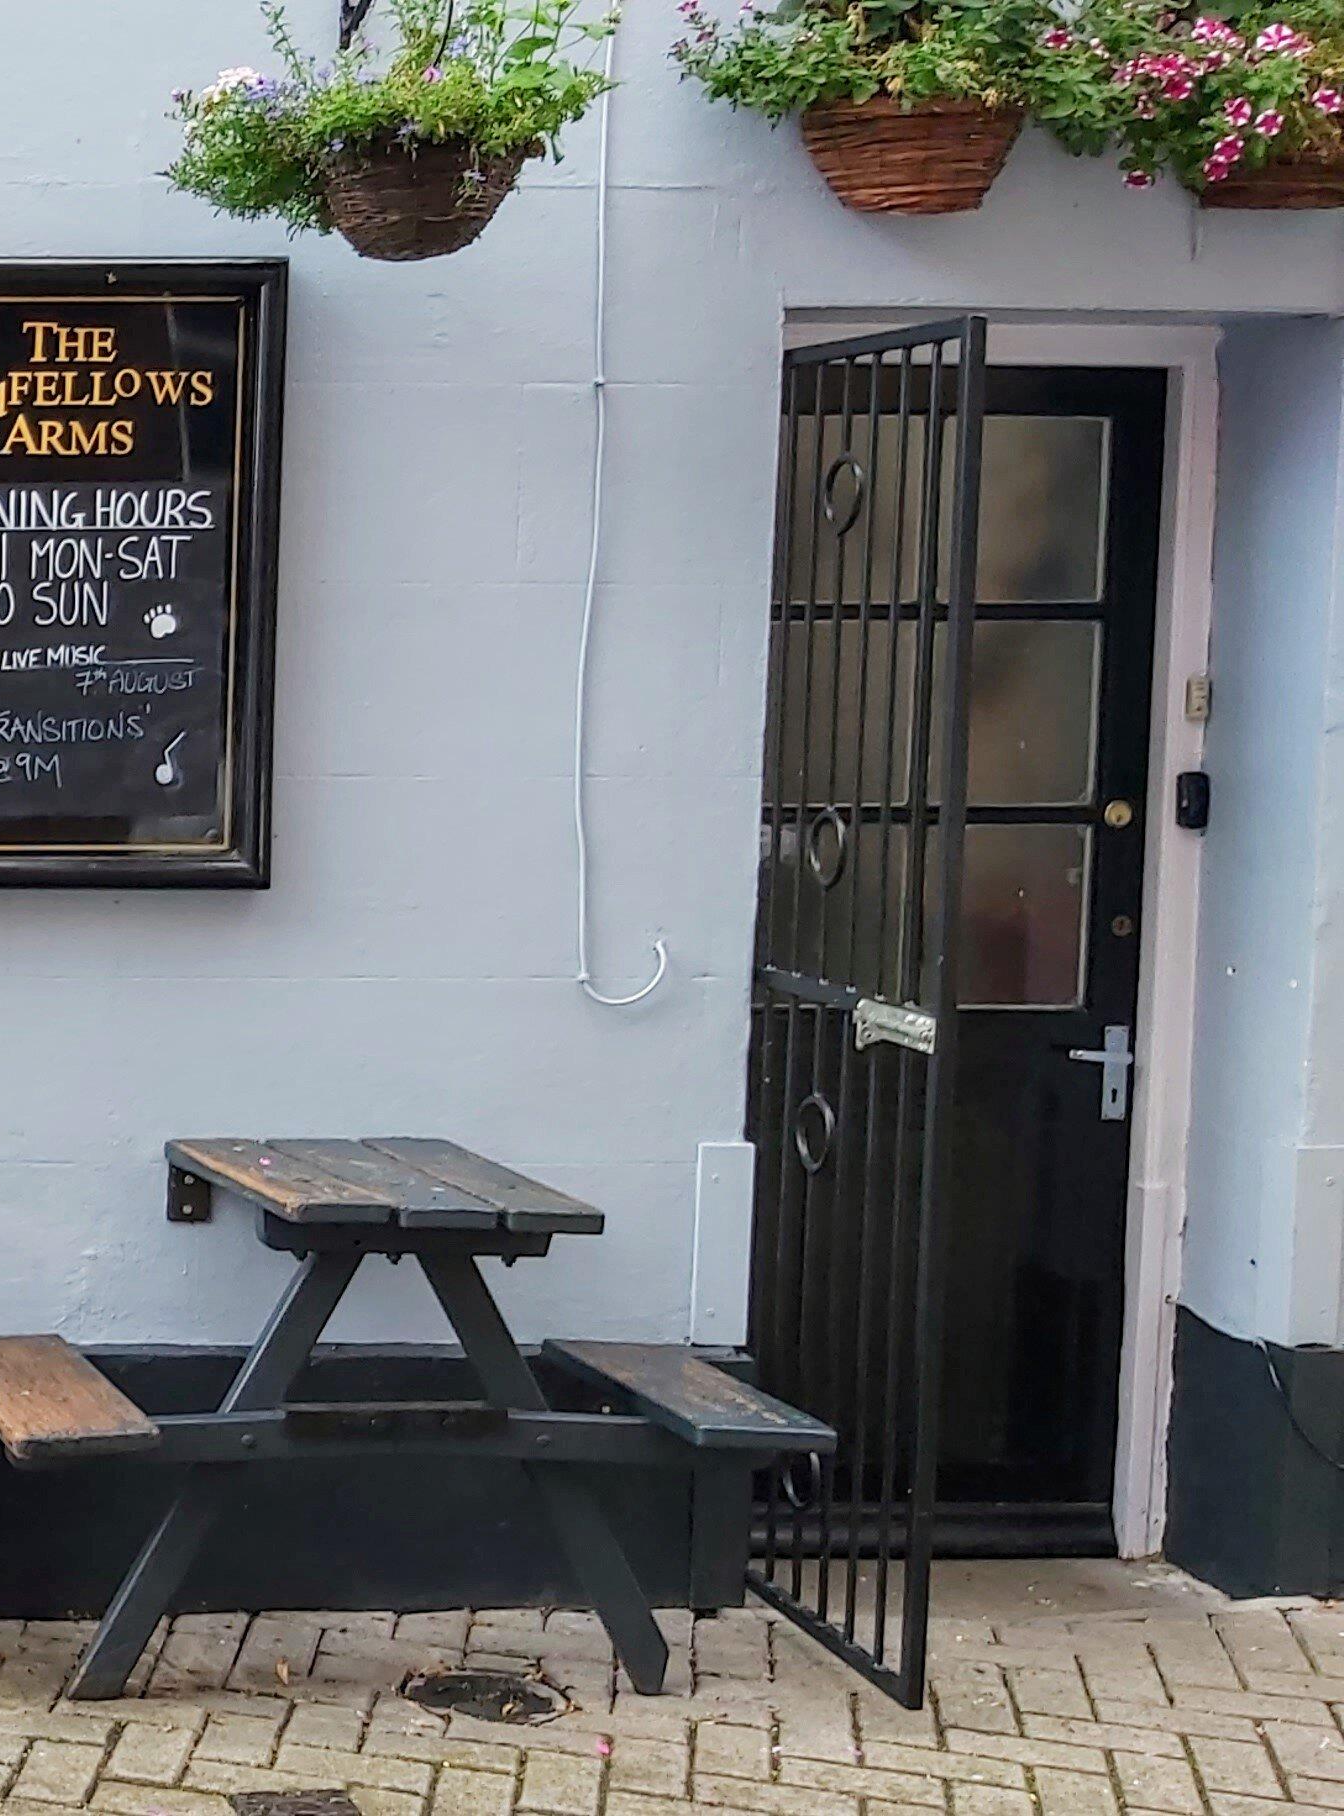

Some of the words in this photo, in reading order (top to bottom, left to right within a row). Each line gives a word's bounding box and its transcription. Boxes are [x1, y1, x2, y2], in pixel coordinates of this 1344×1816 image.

[22, 321, 117, 363] THE
[95, 488, 212, 529] HOURS
[30, 534, 194, 581] MON-SAT
[32, 580, 109, 626] SUN
[0, 648, 42, 670] LIVE
[47, 645, 107, 668] MUSIC
[108, 667, 202, 695] AUGUST
